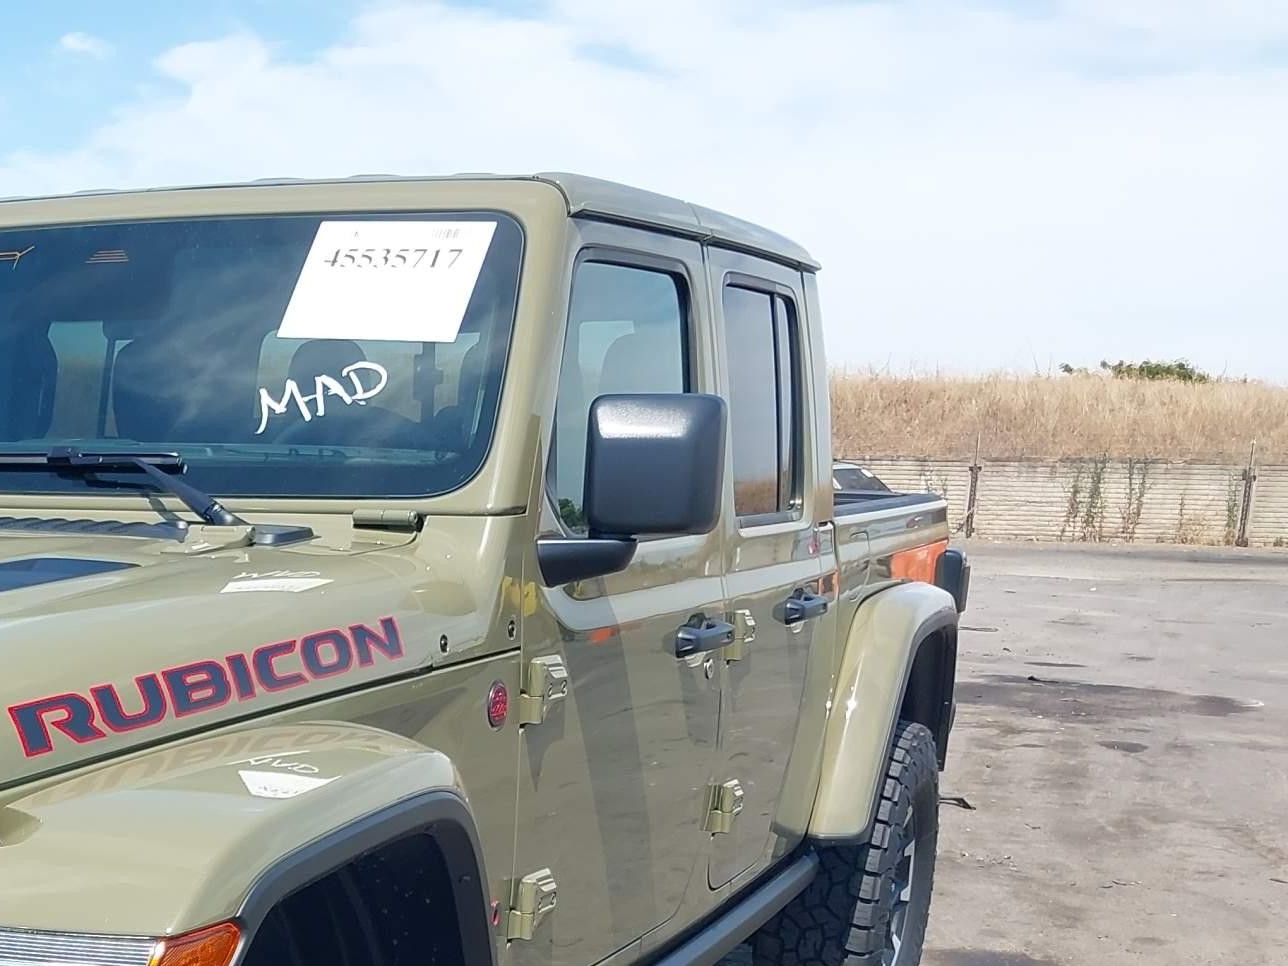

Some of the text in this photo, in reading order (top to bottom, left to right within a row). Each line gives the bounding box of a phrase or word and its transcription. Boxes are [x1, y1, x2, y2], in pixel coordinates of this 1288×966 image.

[324, 248, 464, 269] 45535717
[254, 361, 388, 434] MAD
[7, 616, 405, 758] RUBICON
